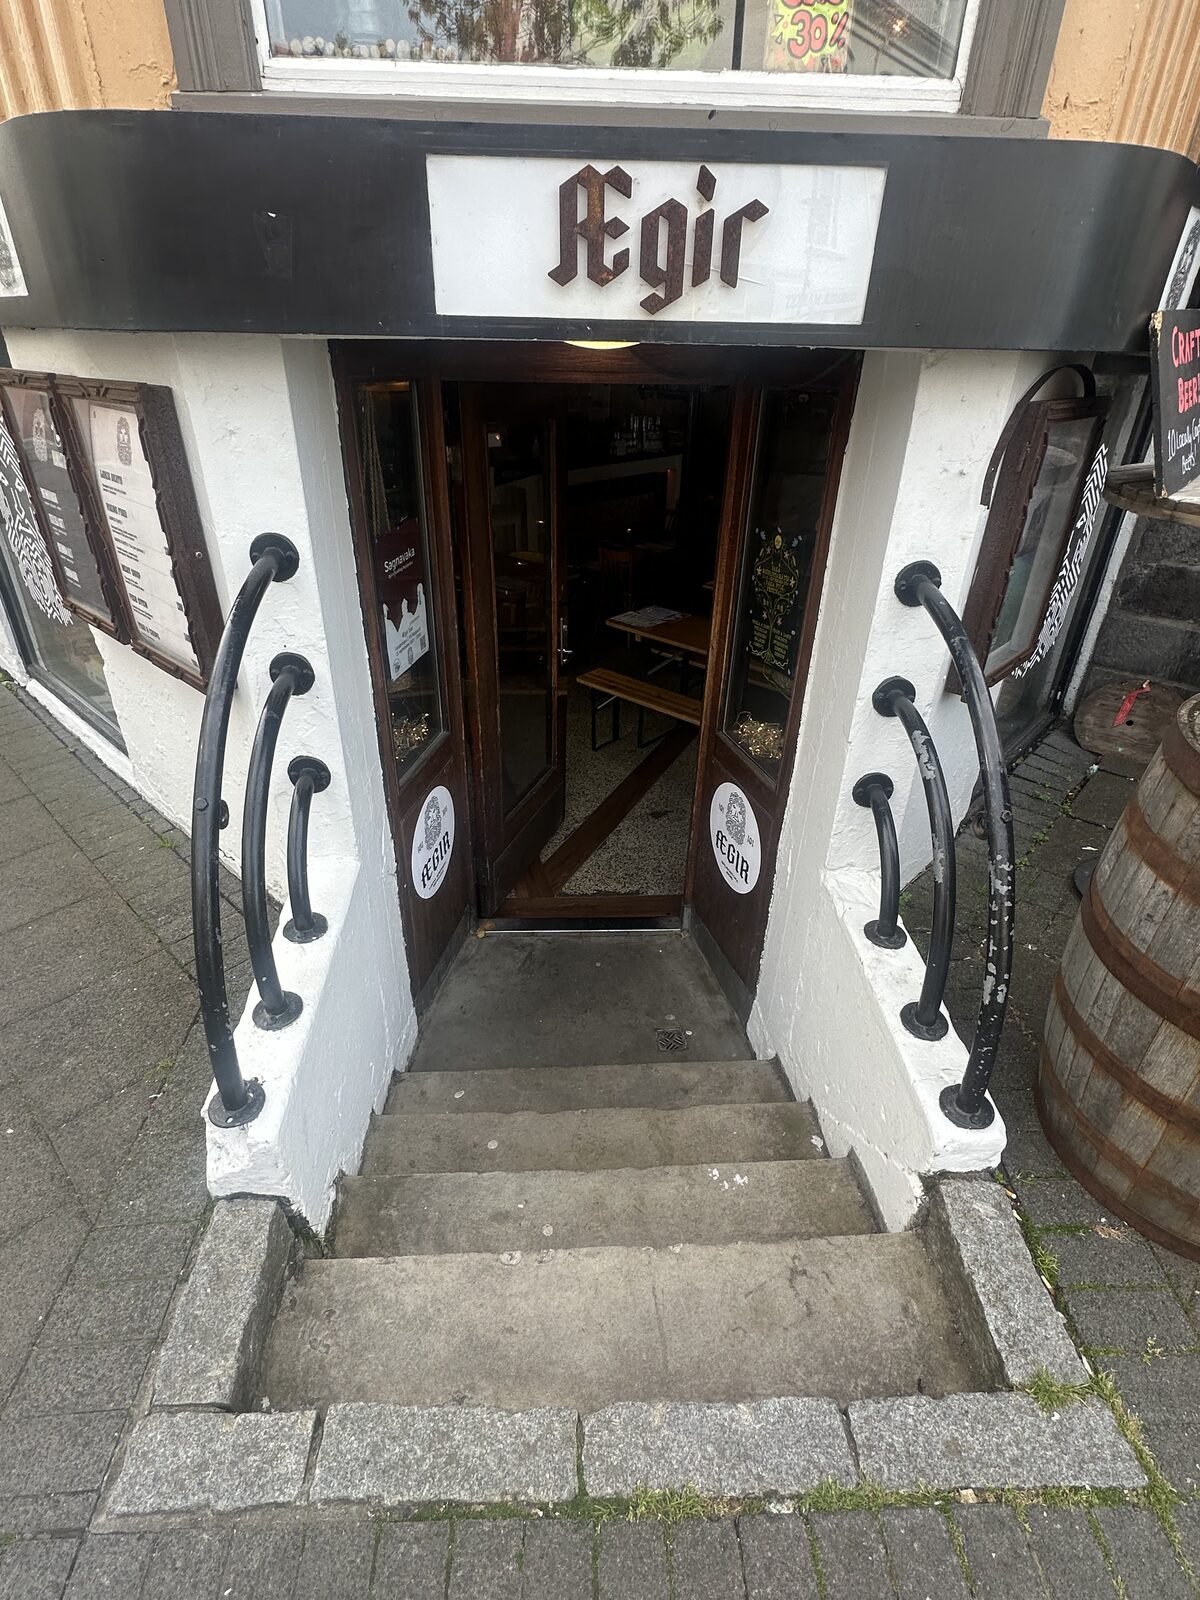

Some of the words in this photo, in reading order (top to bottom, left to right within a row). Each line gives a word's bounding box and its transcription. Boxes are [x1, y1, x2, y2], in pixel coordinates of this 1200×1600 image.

[787, 9, 849, 59] 30%
[548, 164, 769, 315] Ægir
[1167, 428, 1176, 461] 10
[421, 831, 450, 889] ÆGIR
[715, 829, 749, 885] ÆGIR
